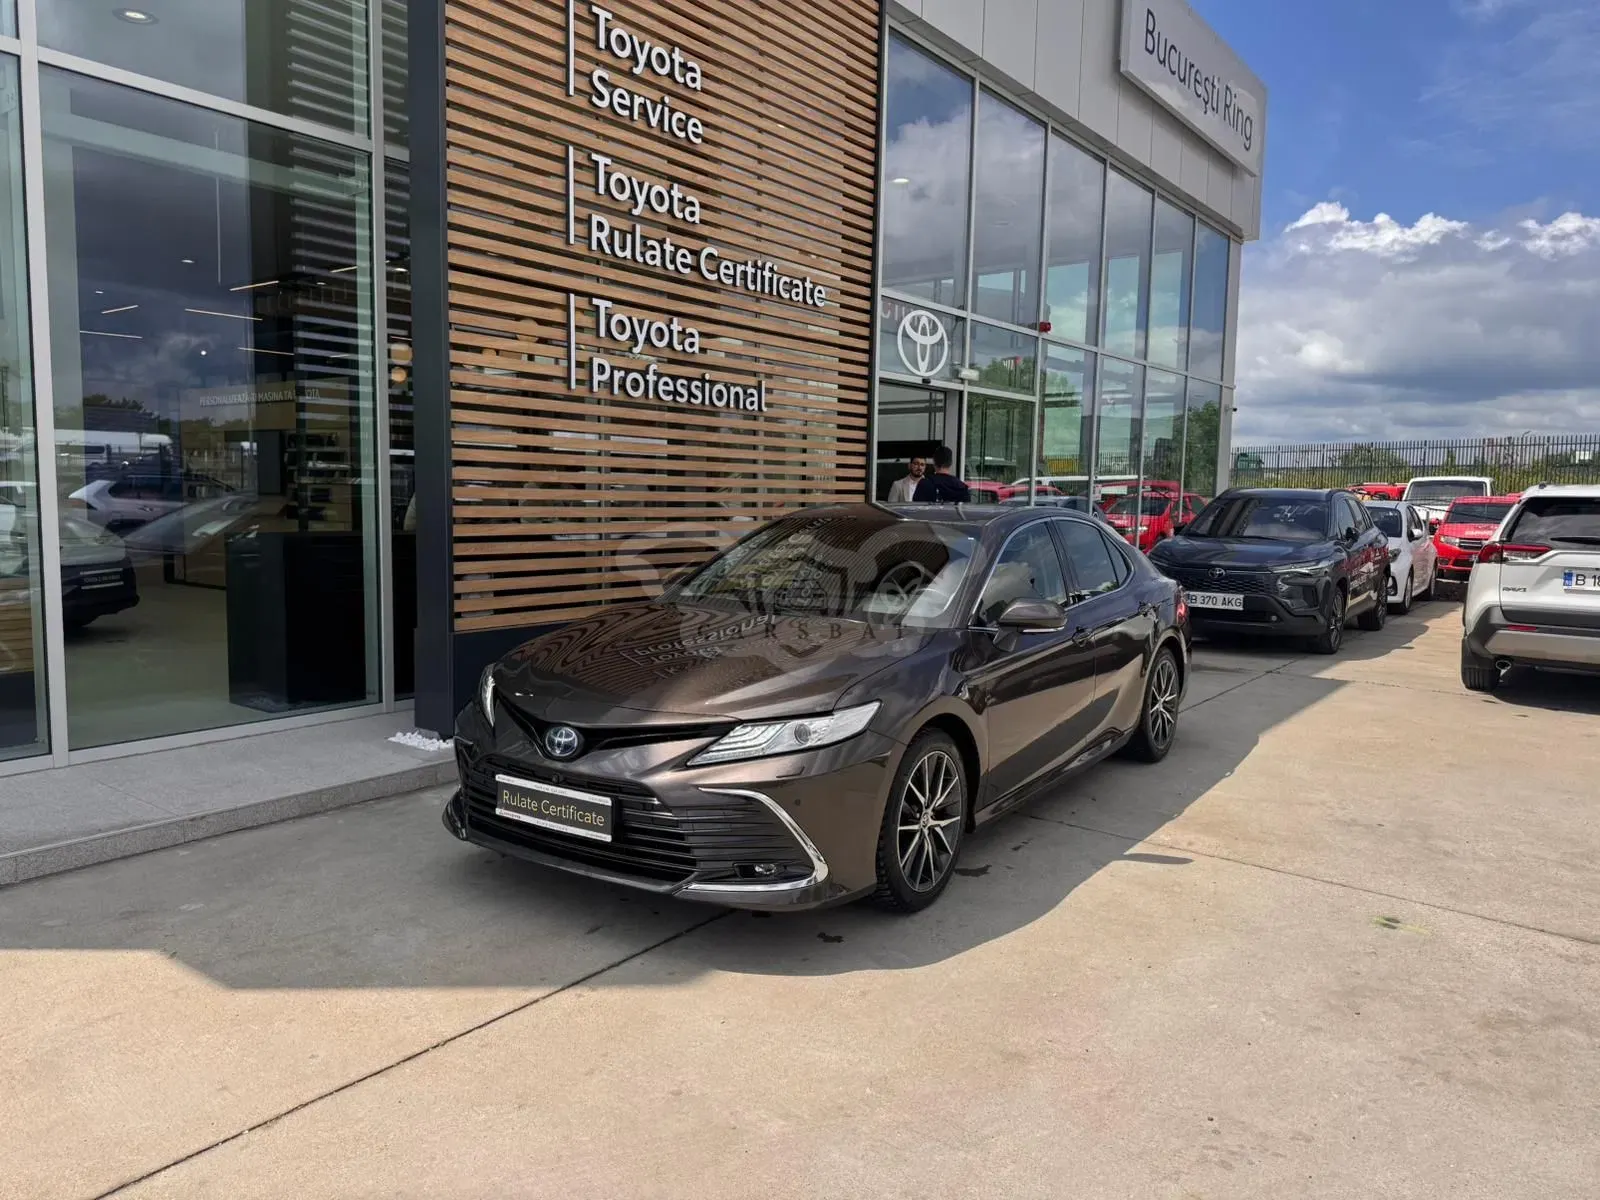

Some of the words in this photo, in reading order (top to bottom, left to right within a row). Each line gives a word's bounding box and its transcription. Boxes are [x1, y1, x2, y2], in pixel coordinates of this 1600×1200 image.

[591, 5, 701, 91] Toyota
[590, 69, 704, 144] Service
[1223, 84, 1253, 151] Ring
[591, 153, 700, 224] Toyota
[588, 214, 692, 273] Rulate
[700, 246, 826, 308] Certificate
[591, 298, 700, 354] Toyota
[591, 357, 767, 412] Professional
[1190, 594, 1198, 604] B
[1201, 595, 1218, 606] 370
[1221, 596, 1242, 607] AKG
[1575, 573, 1586, 586] B
[503, 789, 538, 811] Rulate
[541, 800, 605, 827] Certificate
